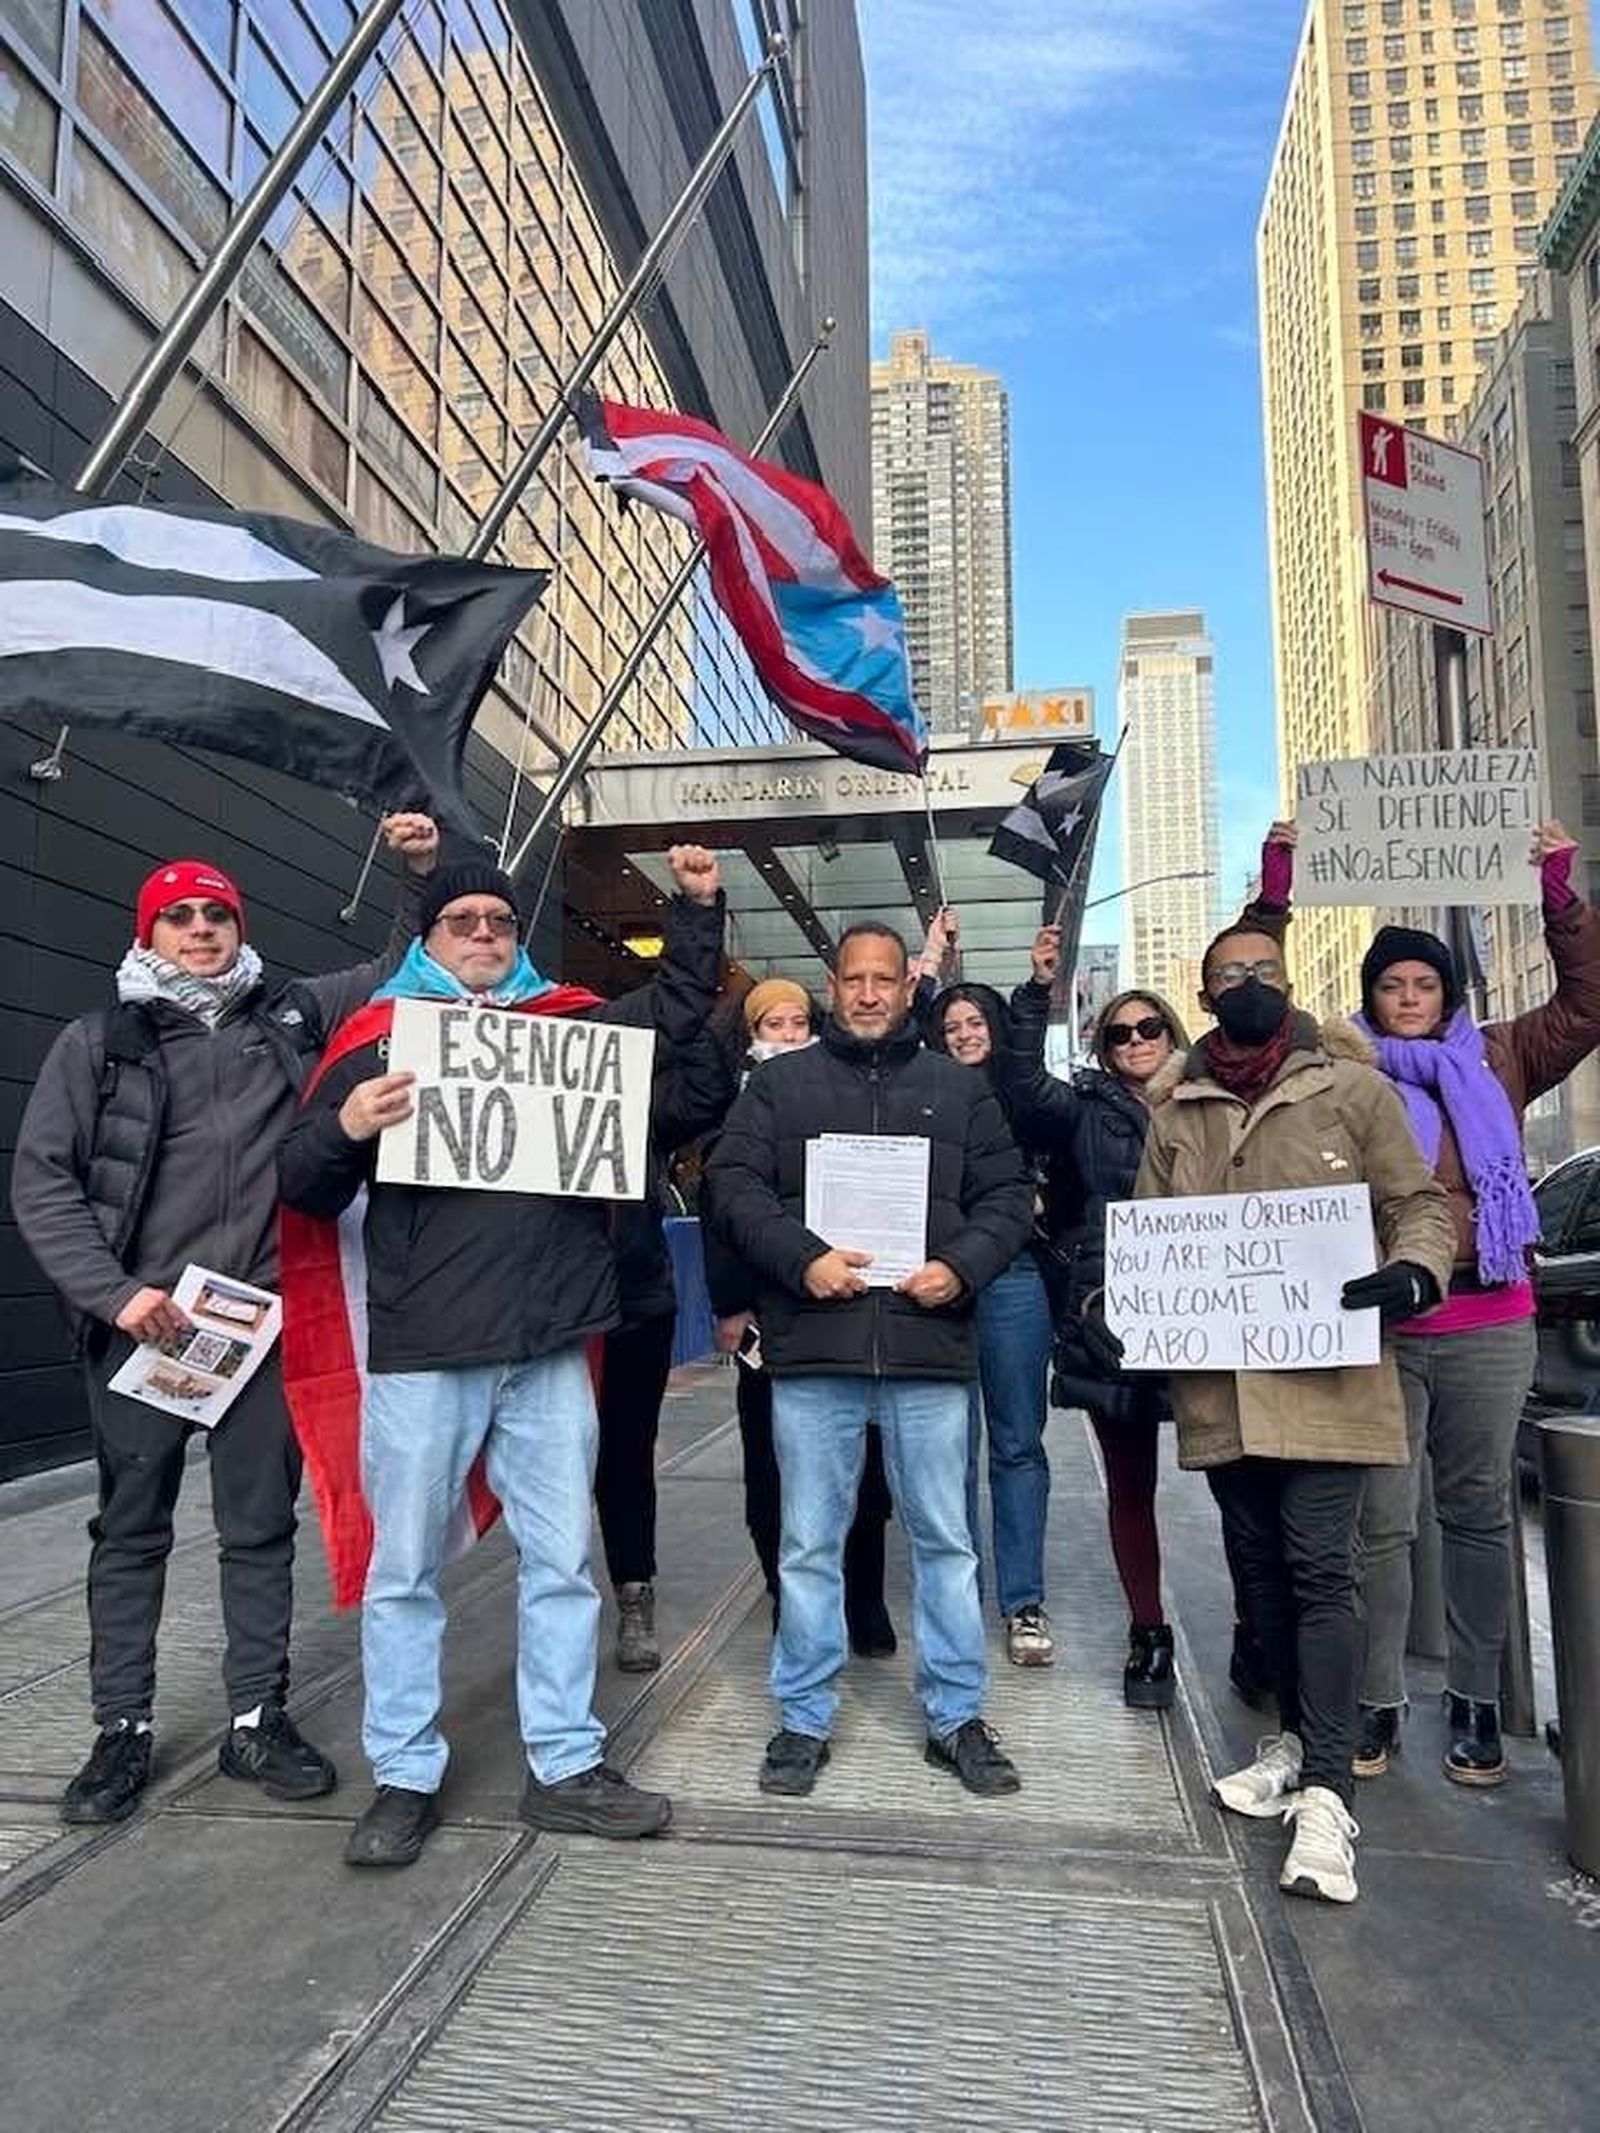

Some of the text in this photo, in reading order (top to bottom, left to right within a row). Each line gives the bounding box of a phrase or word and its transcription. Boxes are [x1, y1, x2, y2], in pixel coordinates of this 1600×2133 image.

[983, 697, 1085, 729] TAXI
[680, 769, 970, 804] MANDARIN ORIENTAL
[1362, 753, 1537, 789] NATURALEZA
[1315, 787, 1530, 834] SE DEFIENDE!
[439, 1008, 623, 1095] ESENCIA
[414, 1086, 629, 1193] NO VA
[1110, 1207, 1227, 1239] MANDARIN
[1109, 1239, 1290, 1276] YOU ARE NOT
[1108, 1280, 1309, 1317] WELCOME IN
[1120, 1319, 1343, 1366] CABO ROJO!
